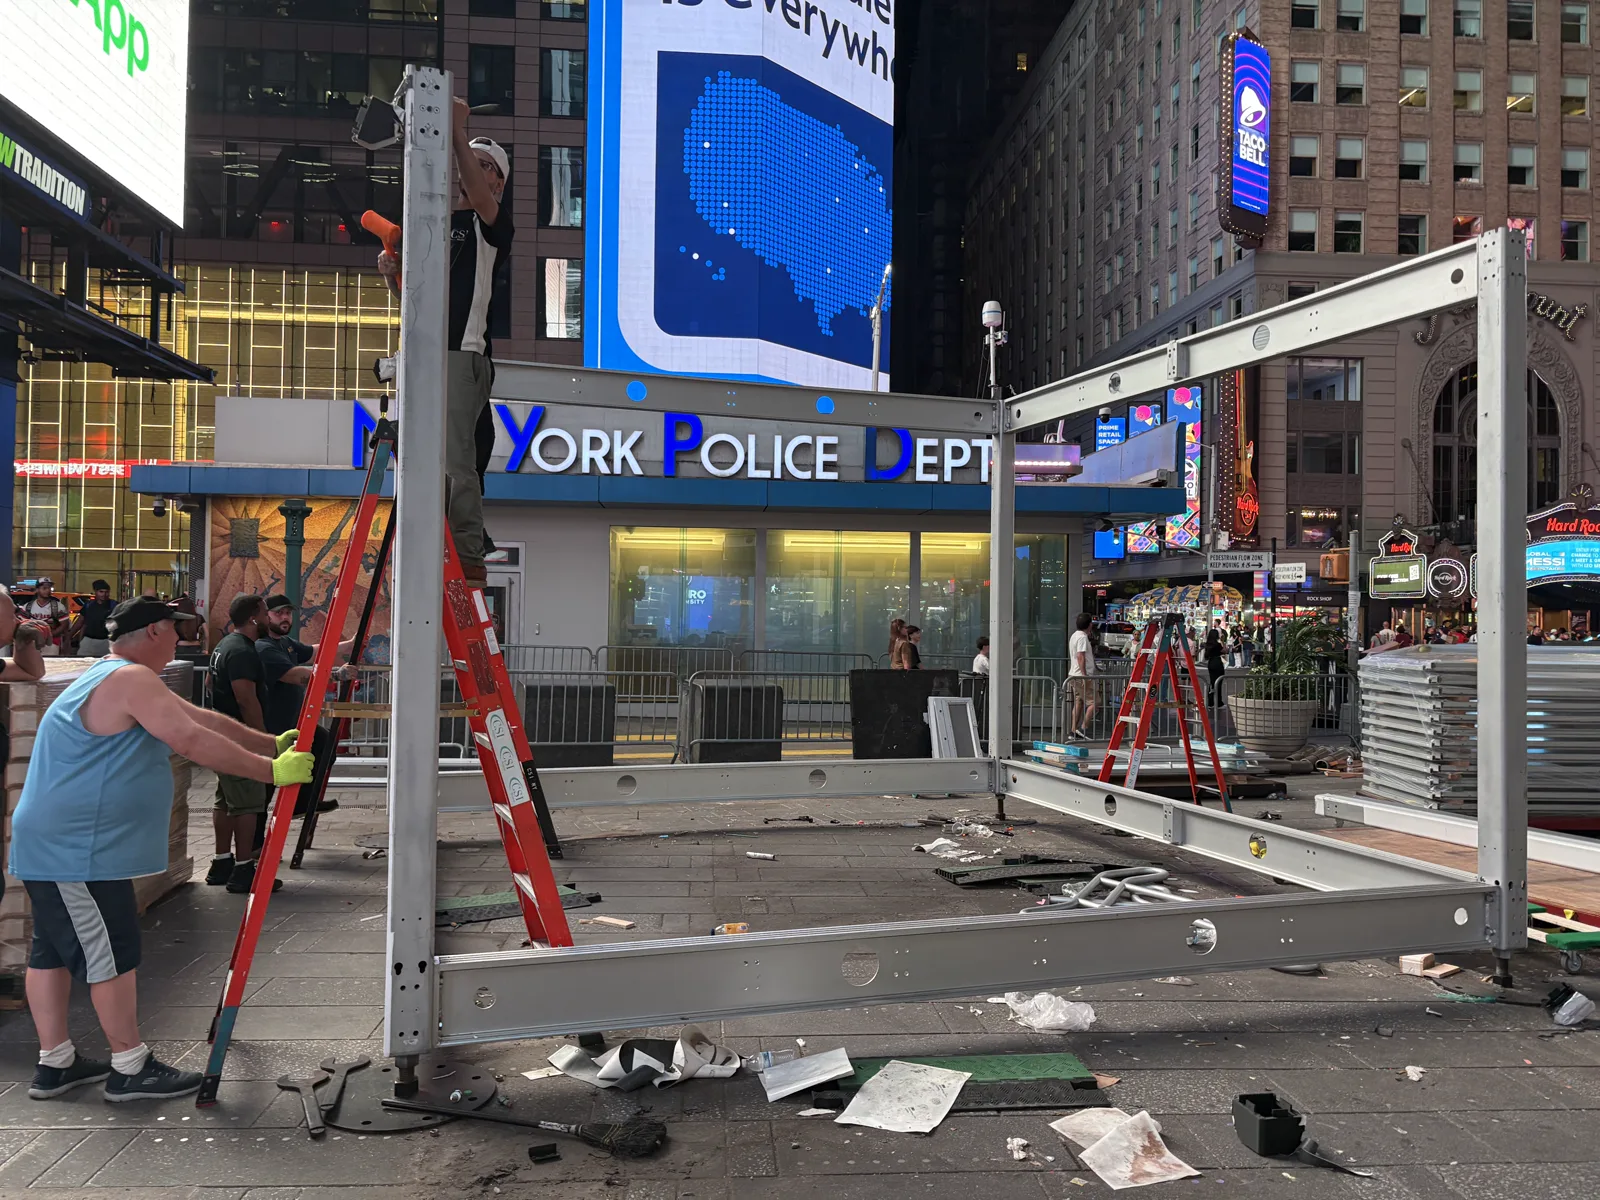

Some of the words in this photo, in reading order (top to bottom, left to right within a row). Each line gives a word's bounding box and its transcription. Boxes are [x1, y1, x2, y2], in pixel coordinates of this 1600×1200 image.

[1238, 128, 1266, 152] TACO
[1239, 145, 1266, 168] BELL
[494, 404, 644, 475] YORK
[663, 411, 839, 479] POLICE
[865, 427, 993, 483] DEPT
[1546, 518, 1578, 532] Hard
